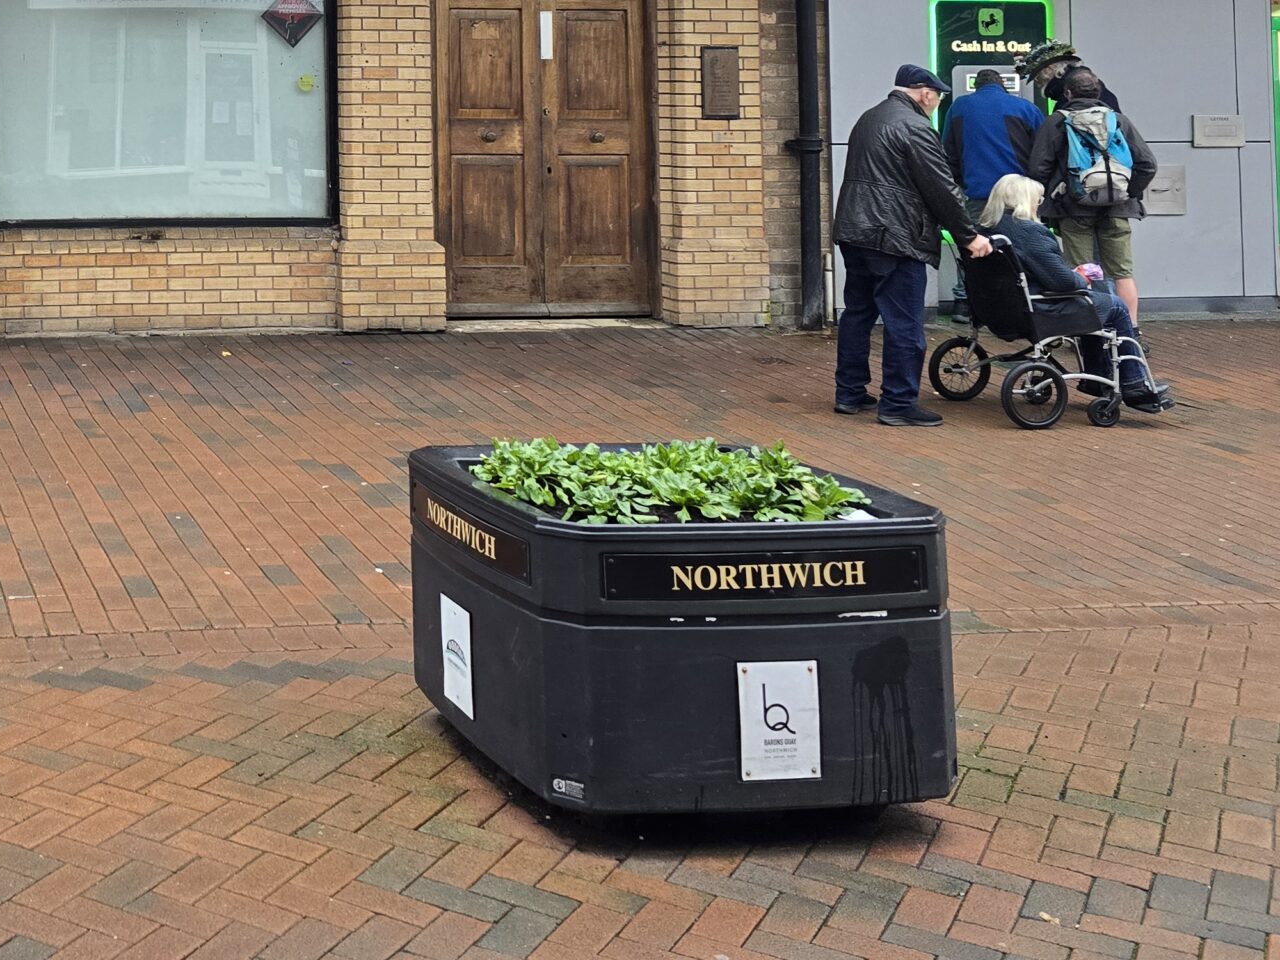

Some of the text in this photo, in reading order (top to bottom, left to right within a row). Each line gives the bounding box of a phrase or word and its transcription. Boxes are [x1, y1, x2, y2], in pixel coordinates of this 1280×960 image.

[951, 40, 1032, 53] Cash In & Out
[427, 497, 496, 560] NORTHWICH
[670, 560, 867, 591] NORTHWICH
[764, 738, 796, 746] BARONS QUAY
